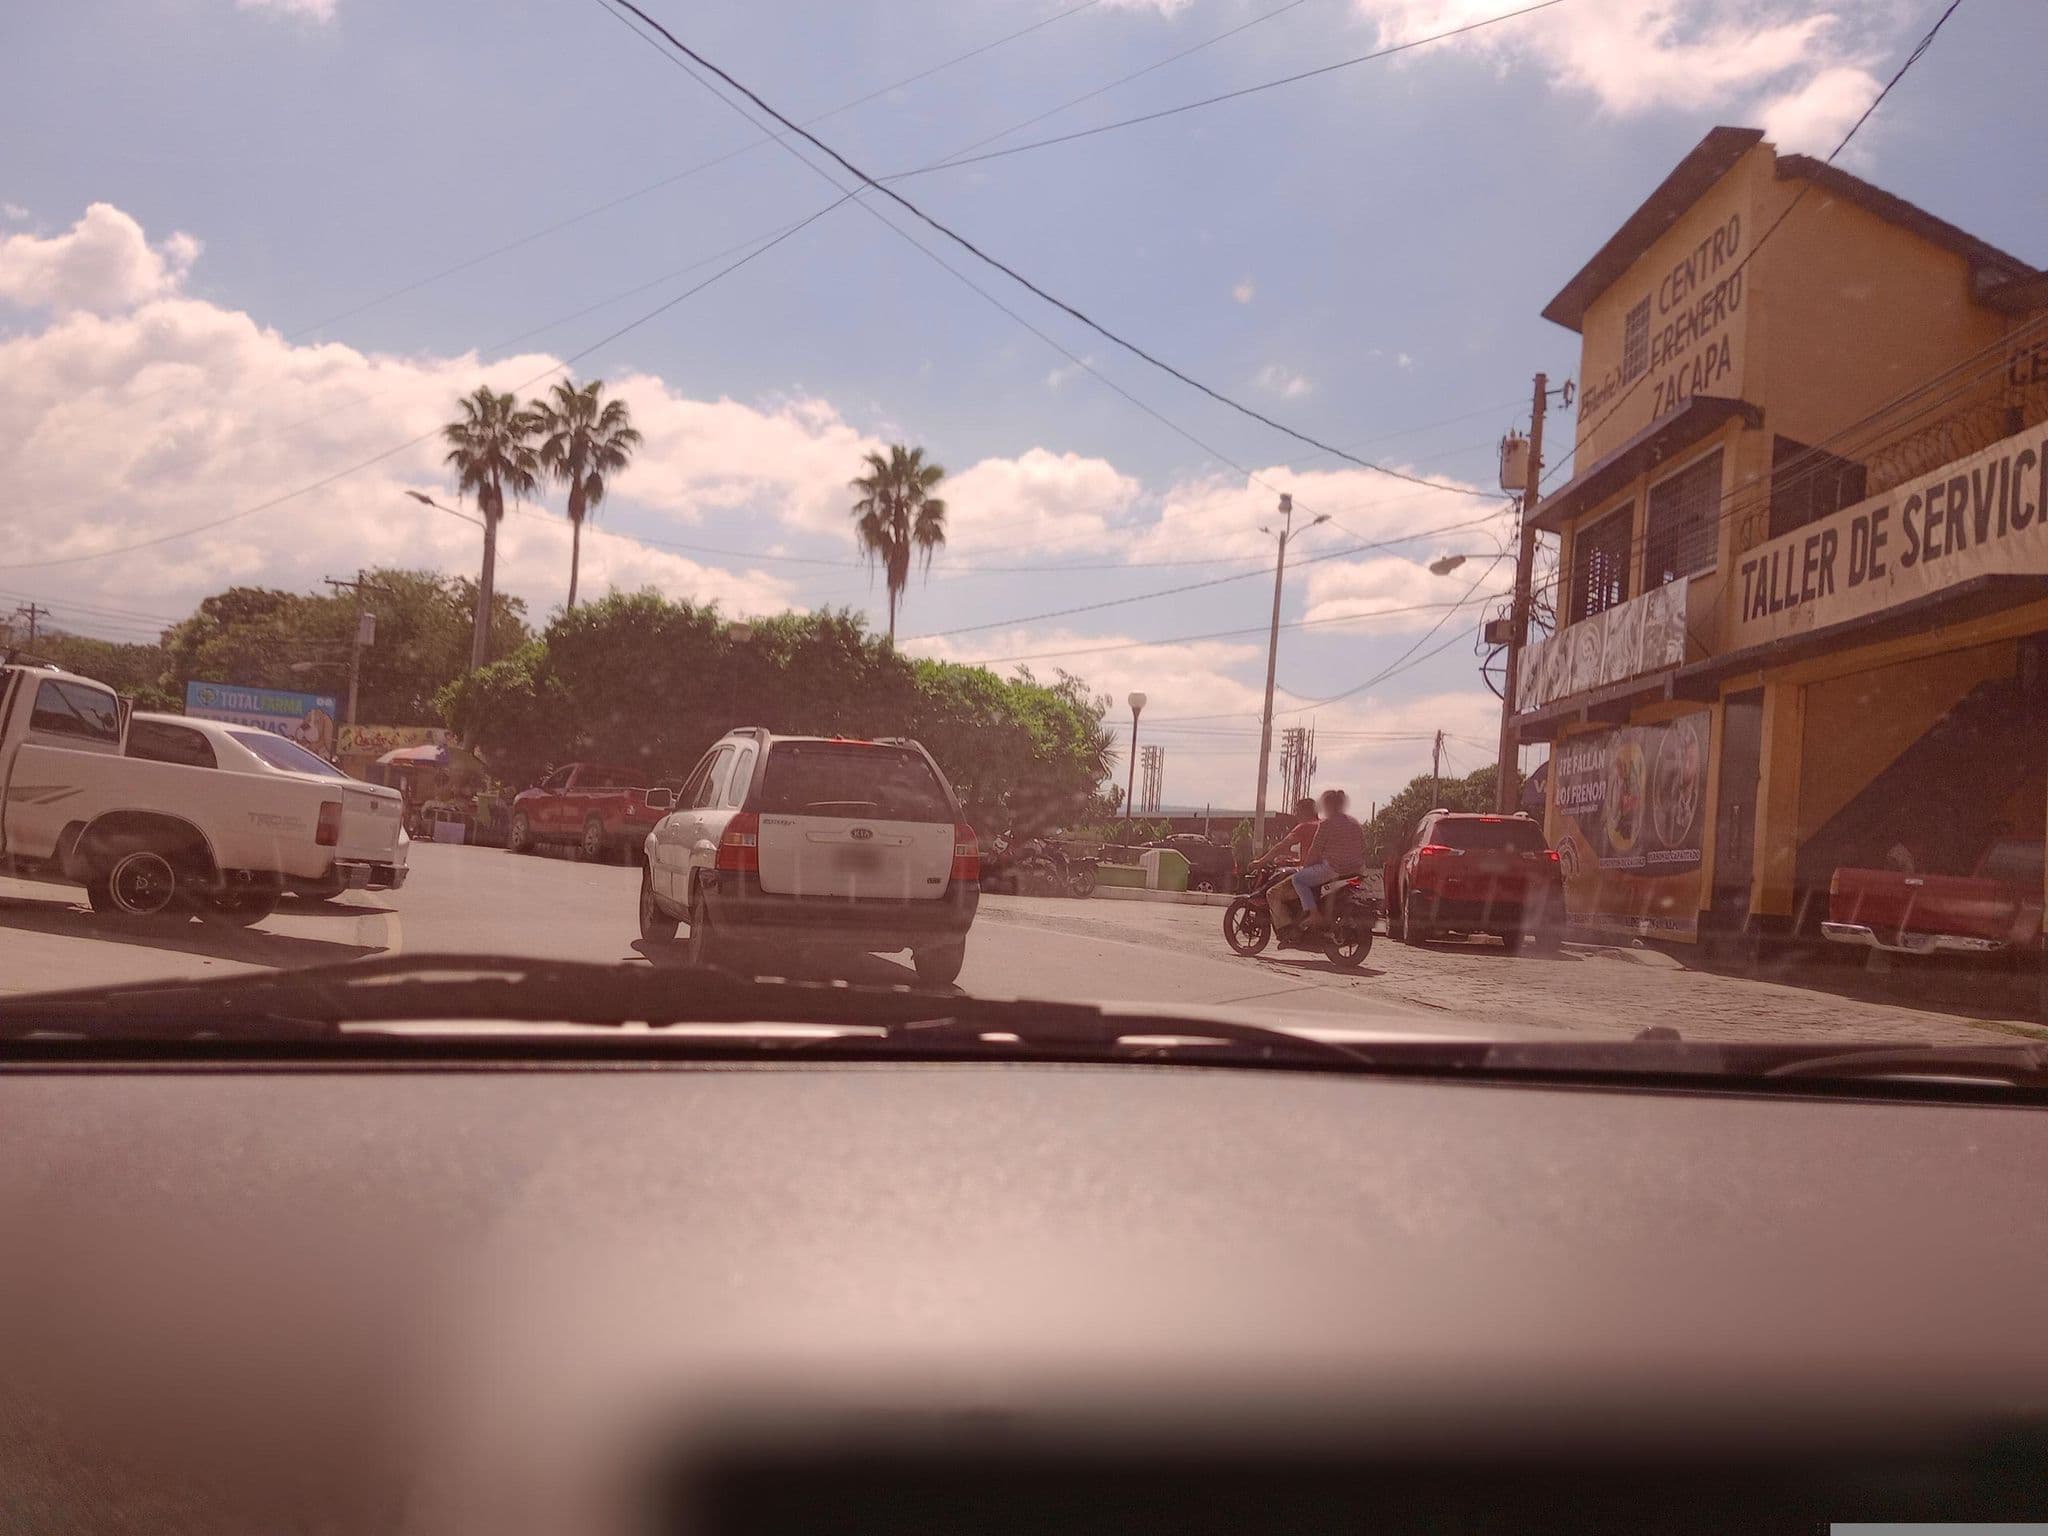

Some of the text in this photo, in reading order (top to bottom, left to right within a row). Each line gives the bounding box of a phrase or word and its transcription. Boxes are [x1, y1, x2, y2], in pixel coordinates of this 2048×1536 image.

[1658, 213, 1740, 315] CENTRO
[1650, 270, 1743, 374] FRENERO
[1652, 333, 1732, 422] ZACAPA
[1741, 528, 1838, 623] TALLER
[1848, 505, 1890, 588] DE
[1555, 784, 1570, 806] LOS
[1573, 749, 1606, 775] FALLAN
